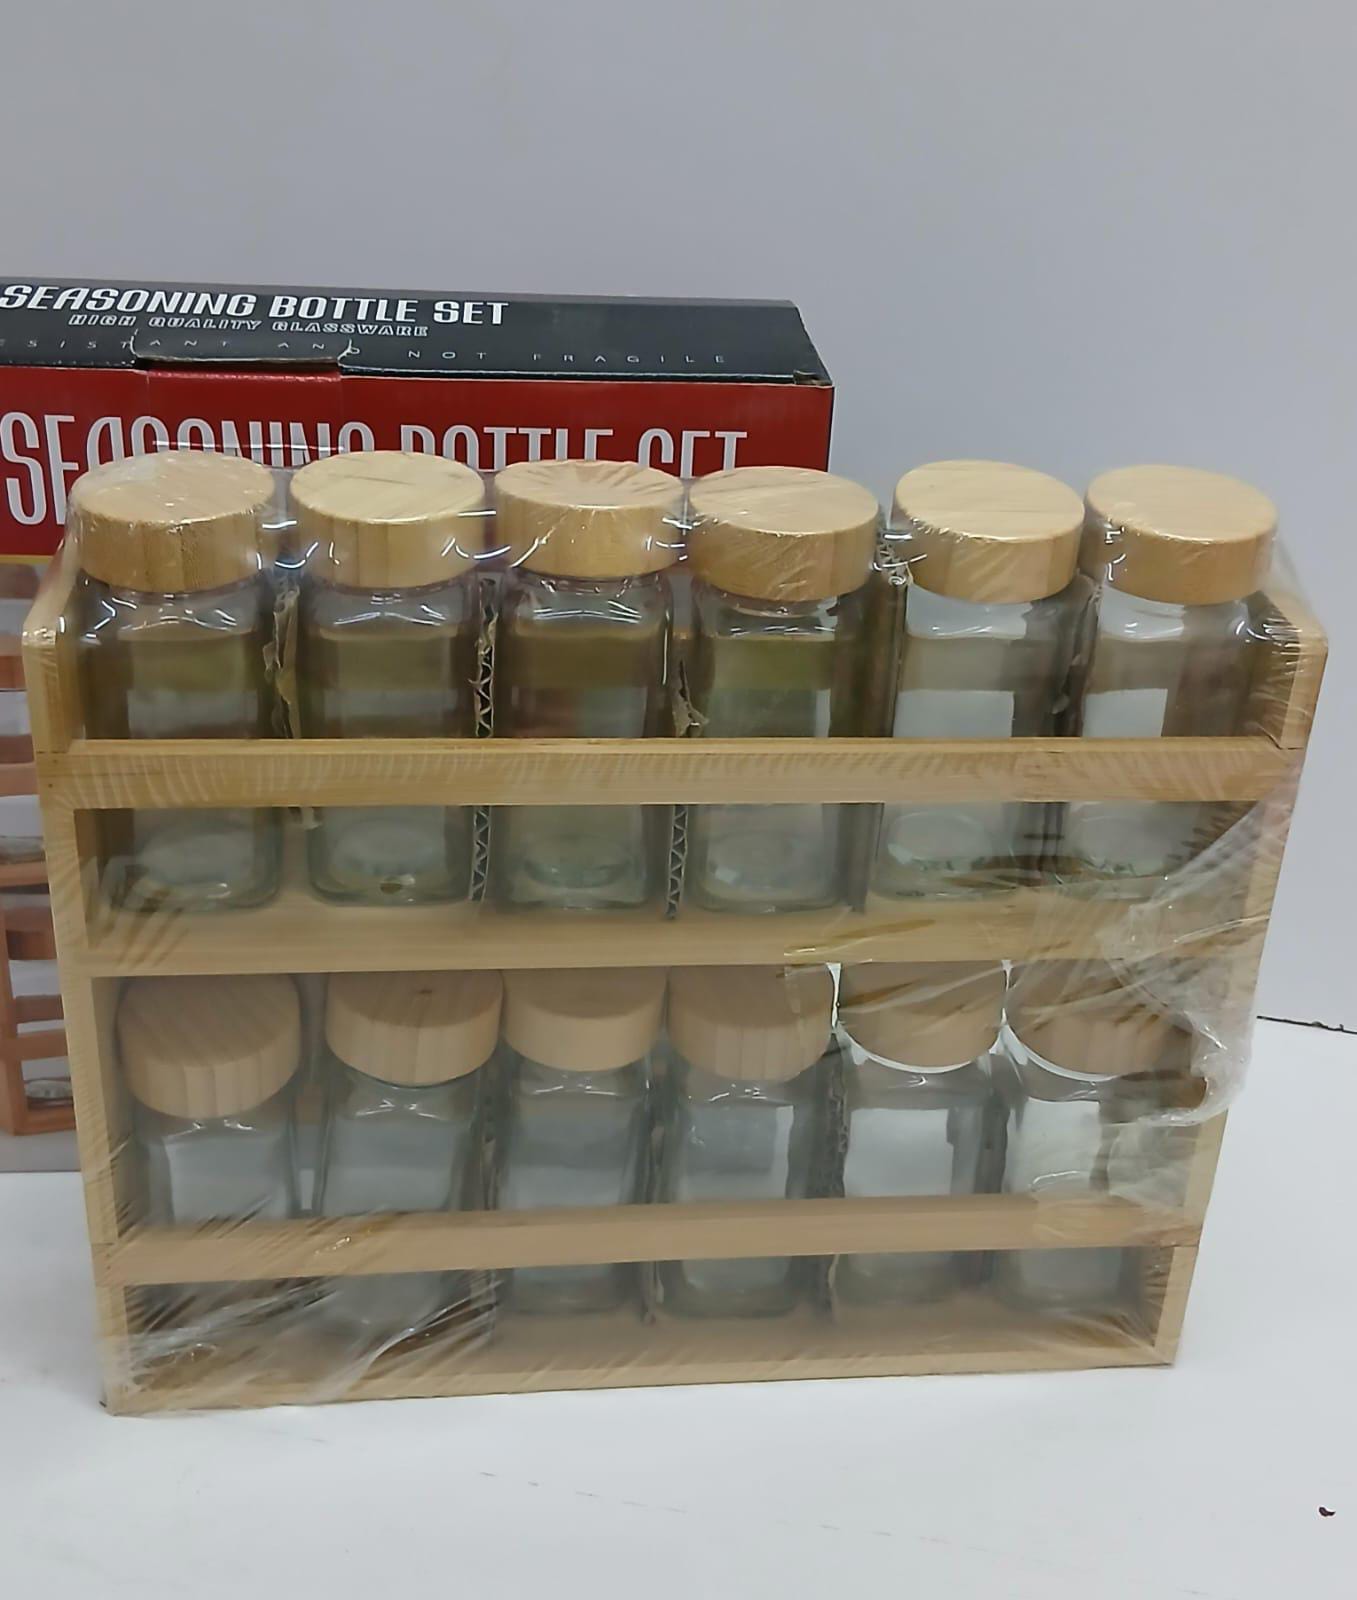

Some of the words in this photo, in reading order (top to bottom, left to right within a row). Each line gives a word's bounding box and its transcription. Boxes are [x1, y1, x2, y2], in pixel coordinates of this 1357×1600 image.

[0, 285, 256, 317] SEASONING
[268, 295, 418, 322] BOTTLE
[433, 301, 509, 325] SET
[68, 314, 137, 326] HIGH
[148, 317, 262, 330] QUALITY
[271, 321, 429, 337] GLASSWARE
[408, 350, 487, 359] NOT
[533, 353, 724, 363] FRAGILE
